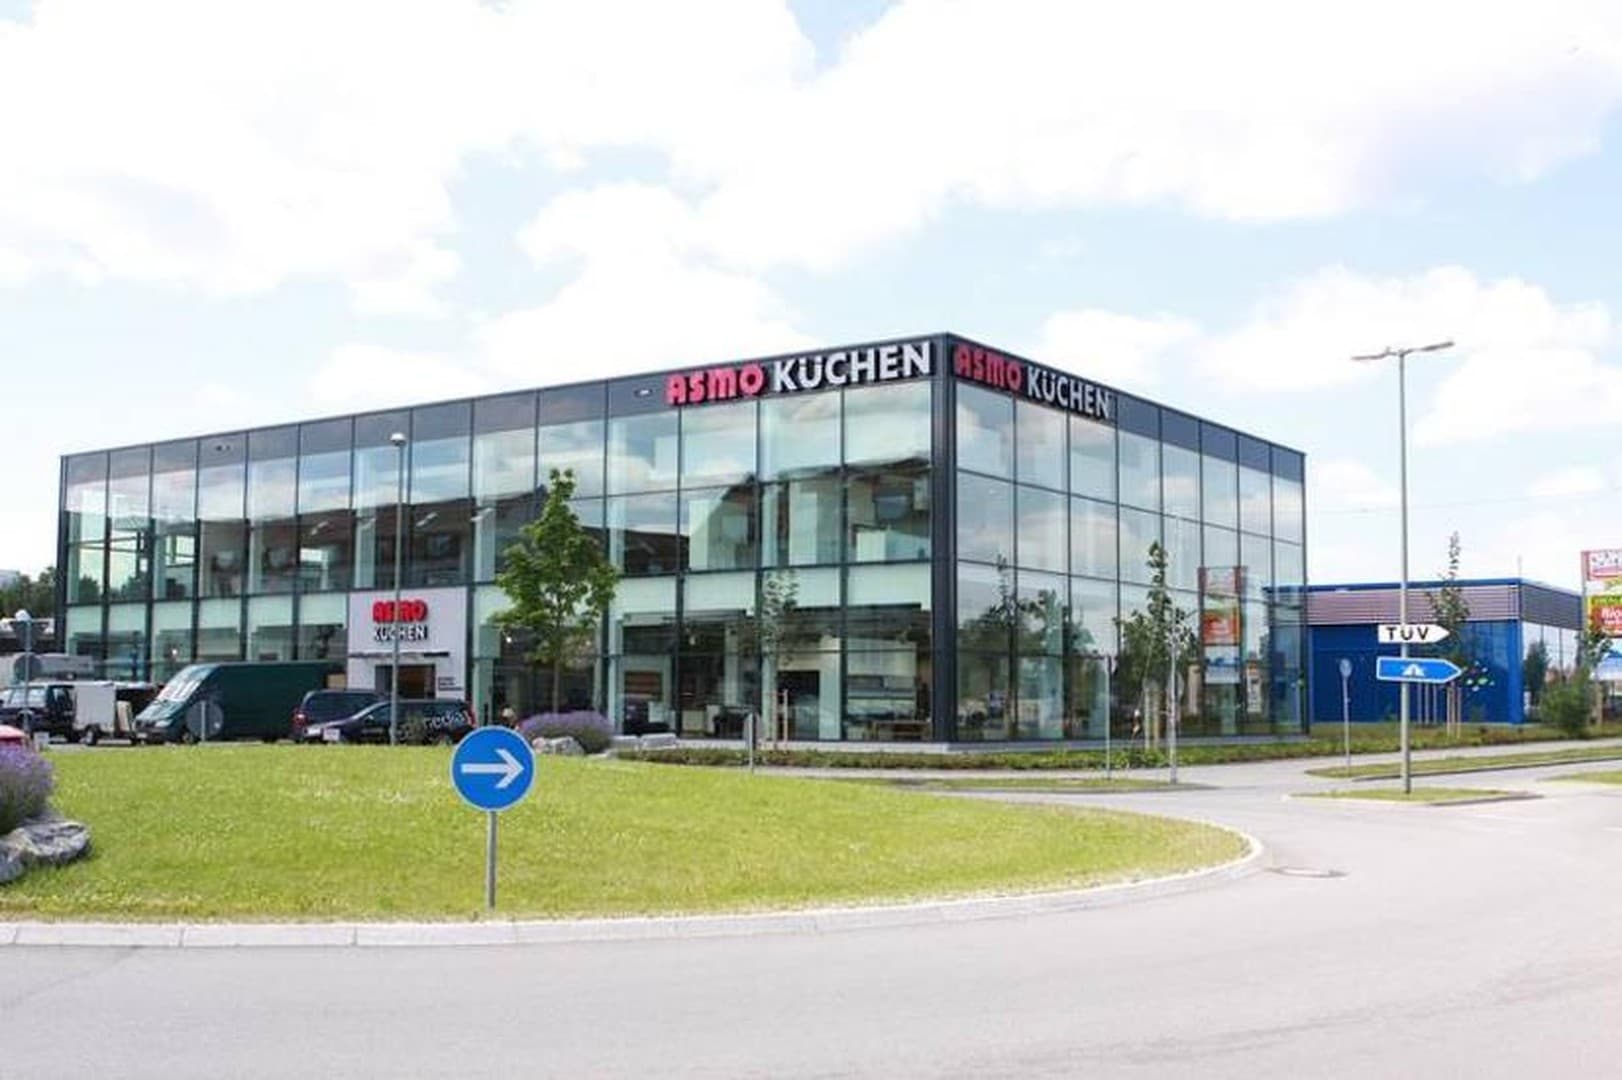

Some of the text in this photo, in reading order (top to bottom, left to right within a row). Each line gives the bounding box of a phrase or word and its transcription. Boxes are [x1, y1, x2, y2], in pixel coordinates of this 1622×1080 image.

[666, 341, 932, 405] ASMO KÜCHEN
[954, 343, 1109, 418] ASMO KÜCHEN
